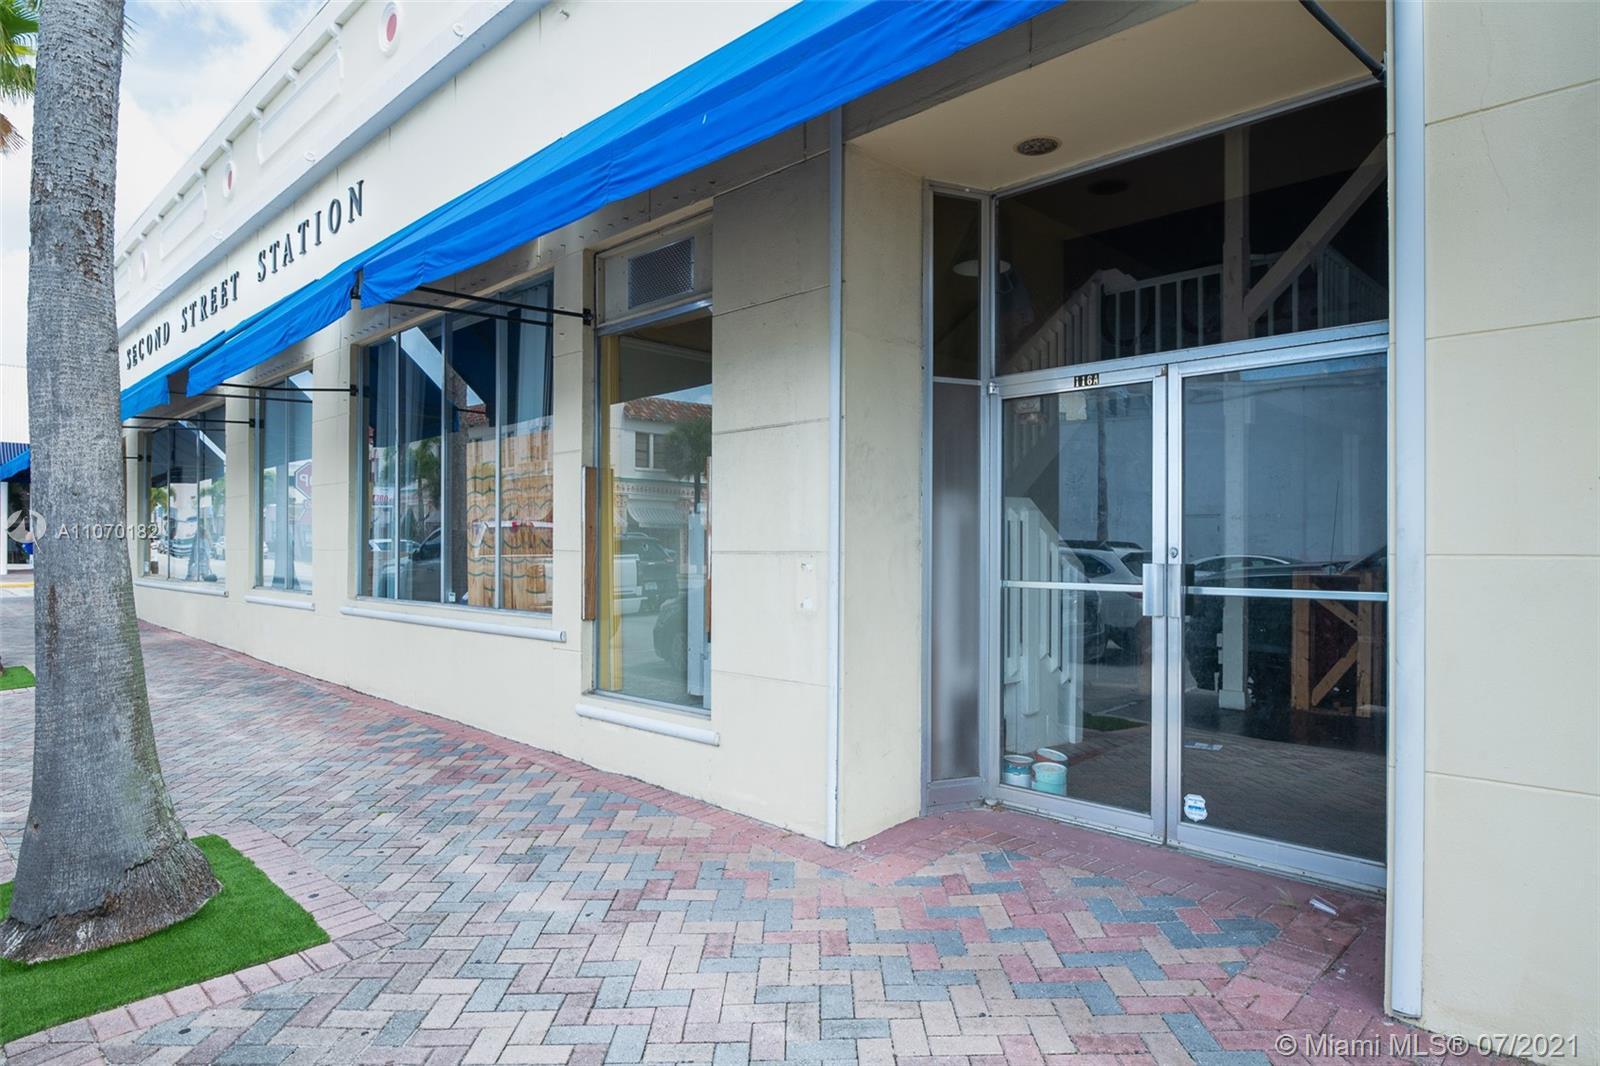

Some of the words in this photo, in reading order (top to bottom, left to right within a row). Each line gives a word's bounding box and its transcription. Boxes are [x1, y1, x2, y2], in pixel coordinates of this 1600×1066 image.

[126, 321, 170, 370] SECOND
[181, 271, 239, 333] STREET
[256, 179, 365, 282] STATION
[1075, 374, 1099, 388] 116A
